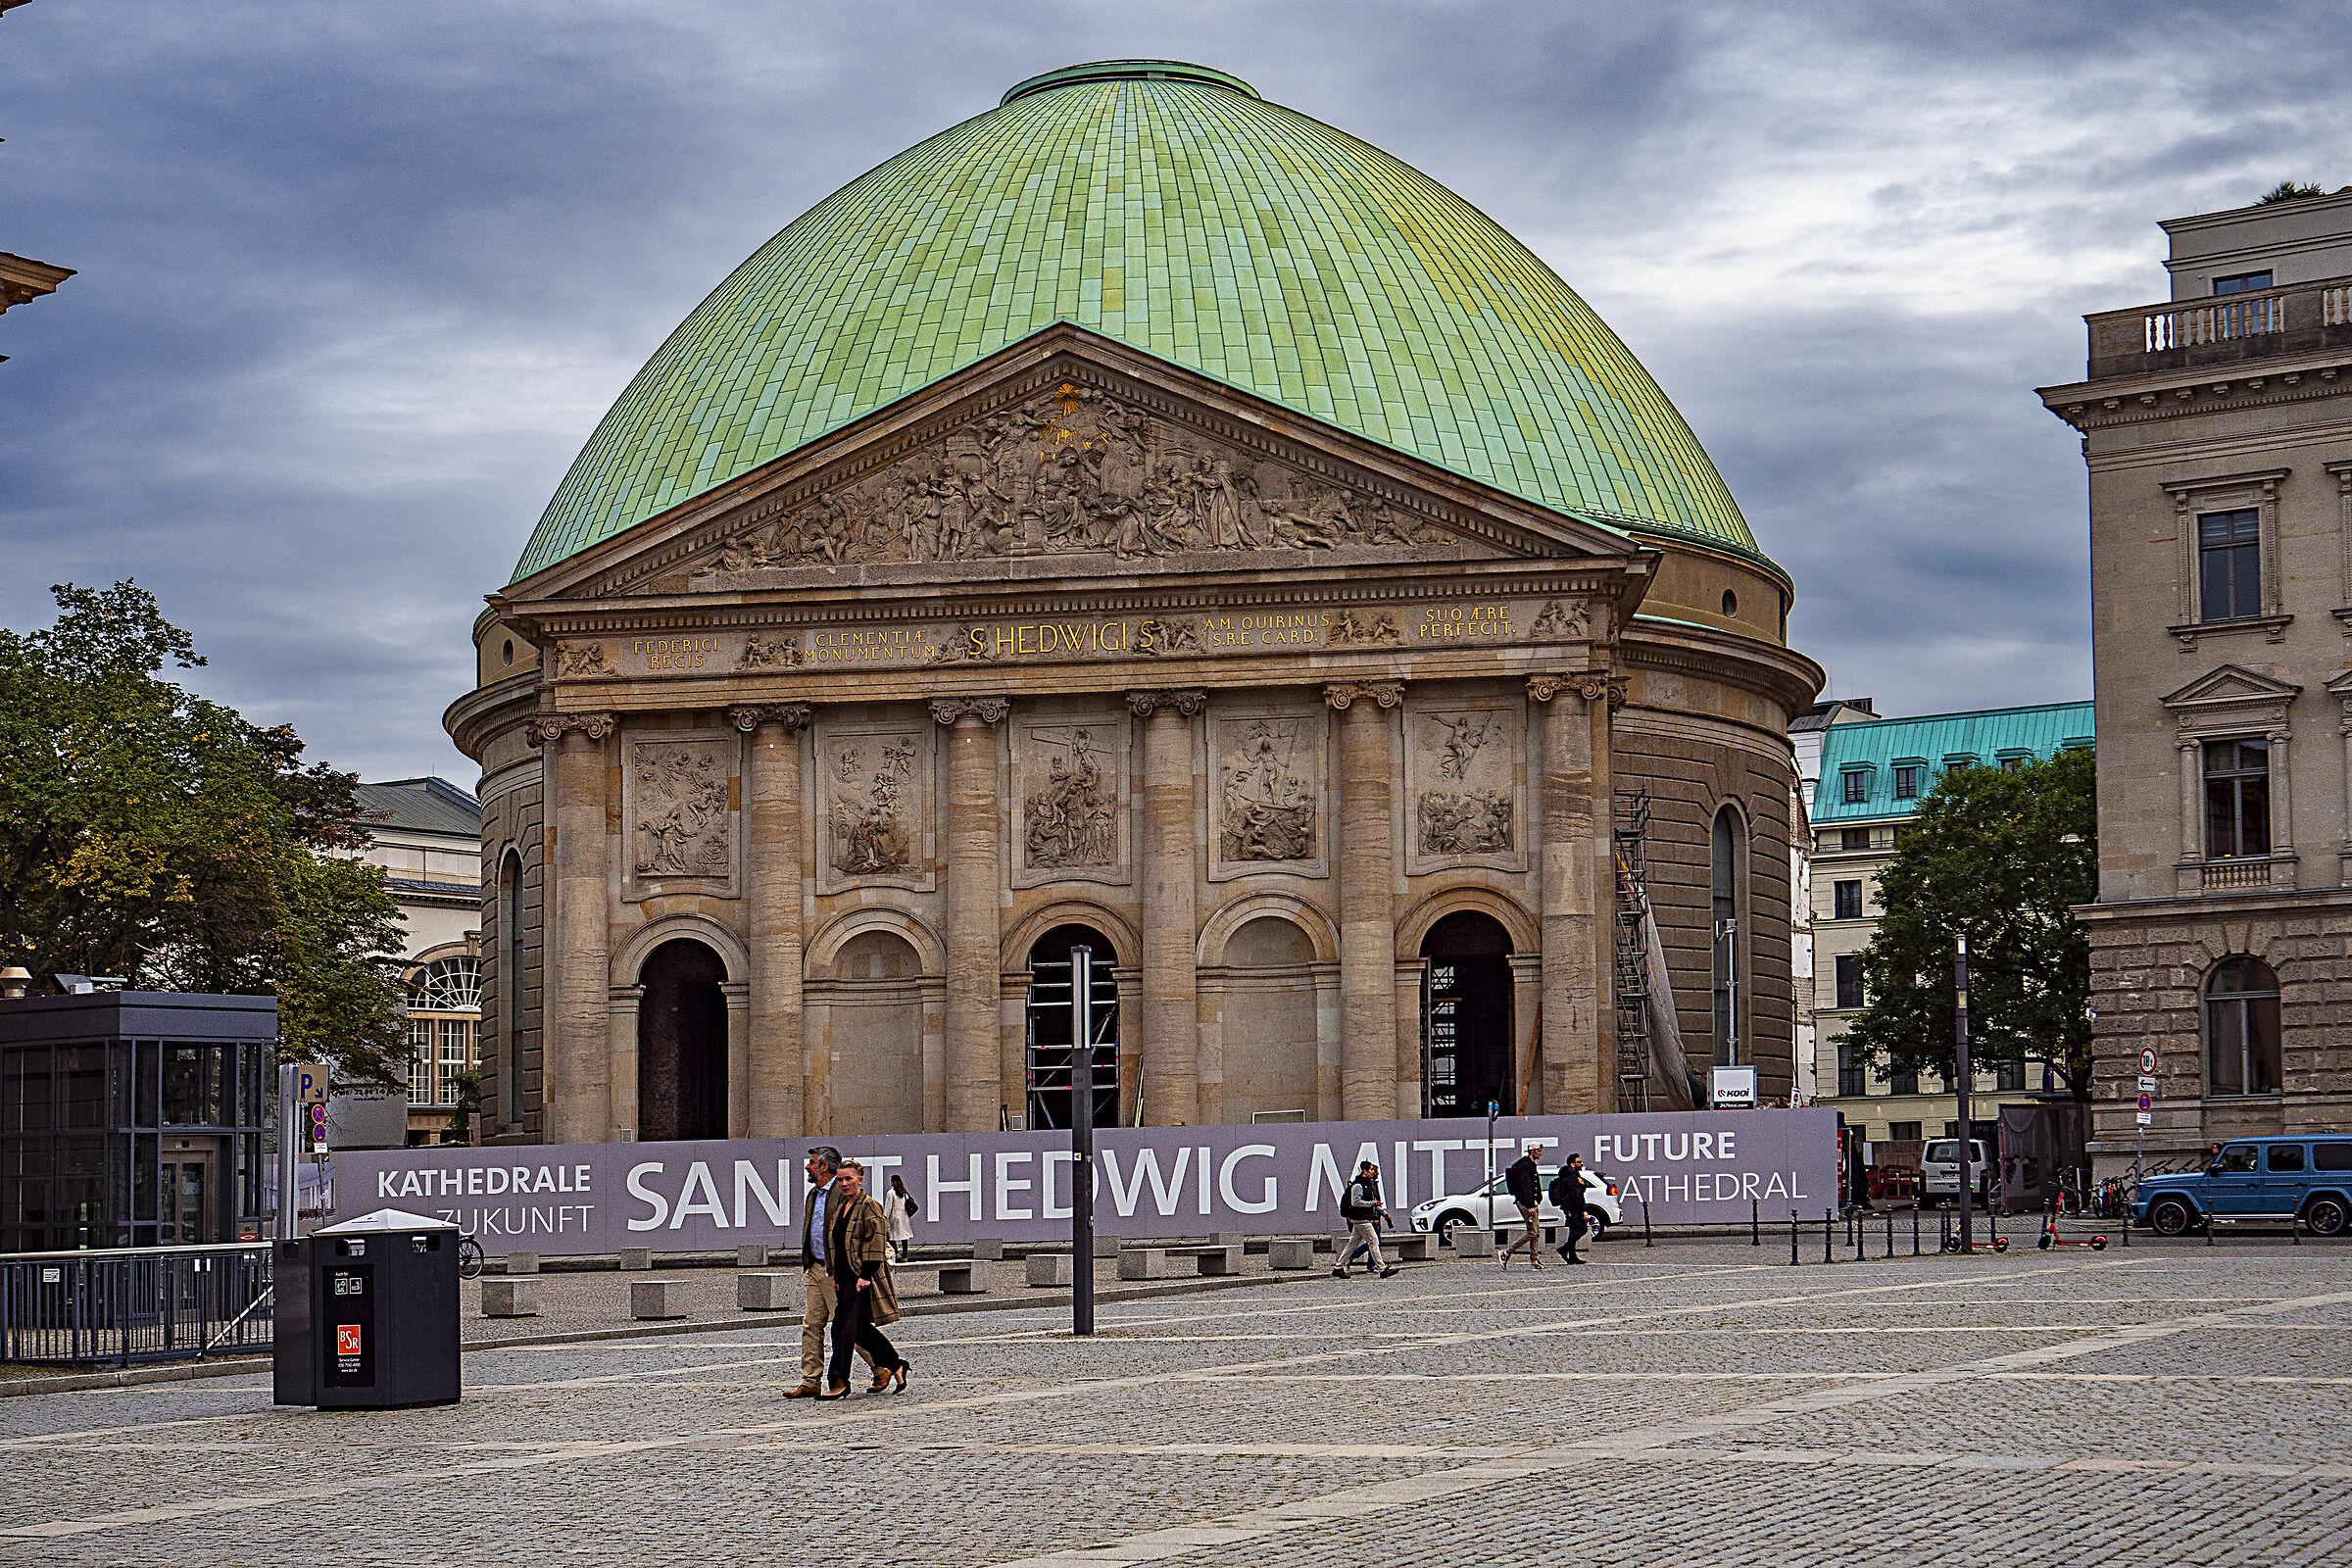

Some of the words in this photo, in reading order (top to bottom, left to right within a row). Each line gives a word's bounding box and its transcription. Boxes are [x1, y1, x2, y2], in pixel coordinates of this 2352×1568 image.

[1241, 613, 1330, 630] QUIRINUS
[1426, 608, 1462, 622] SUO
[1419, 620, 1516, 638] PERFECIT.
[633, 638, 718, 655] FEDERICI
[815, 629, 926, 647] CLEMENTIÆ
[1212, 631, 1254, 647] S.R.E.
[650, 654, 705, 669] REGIS
[804, 645, 935, 662] MONUMENTUM
[300, 1073, 314, 1099] P
[1594, 1132, 1736, 1163] FUTURE
[378, 1164, 591, 1199] KATHEDRALE
[626, 1155, 903, 1232] SANT
[926, 1144, 1278, 1223] HEDWIG
[1603, 1171, 1808, 1203] ATHEDRAL
[340, 1331, 358, 1348] BSR
